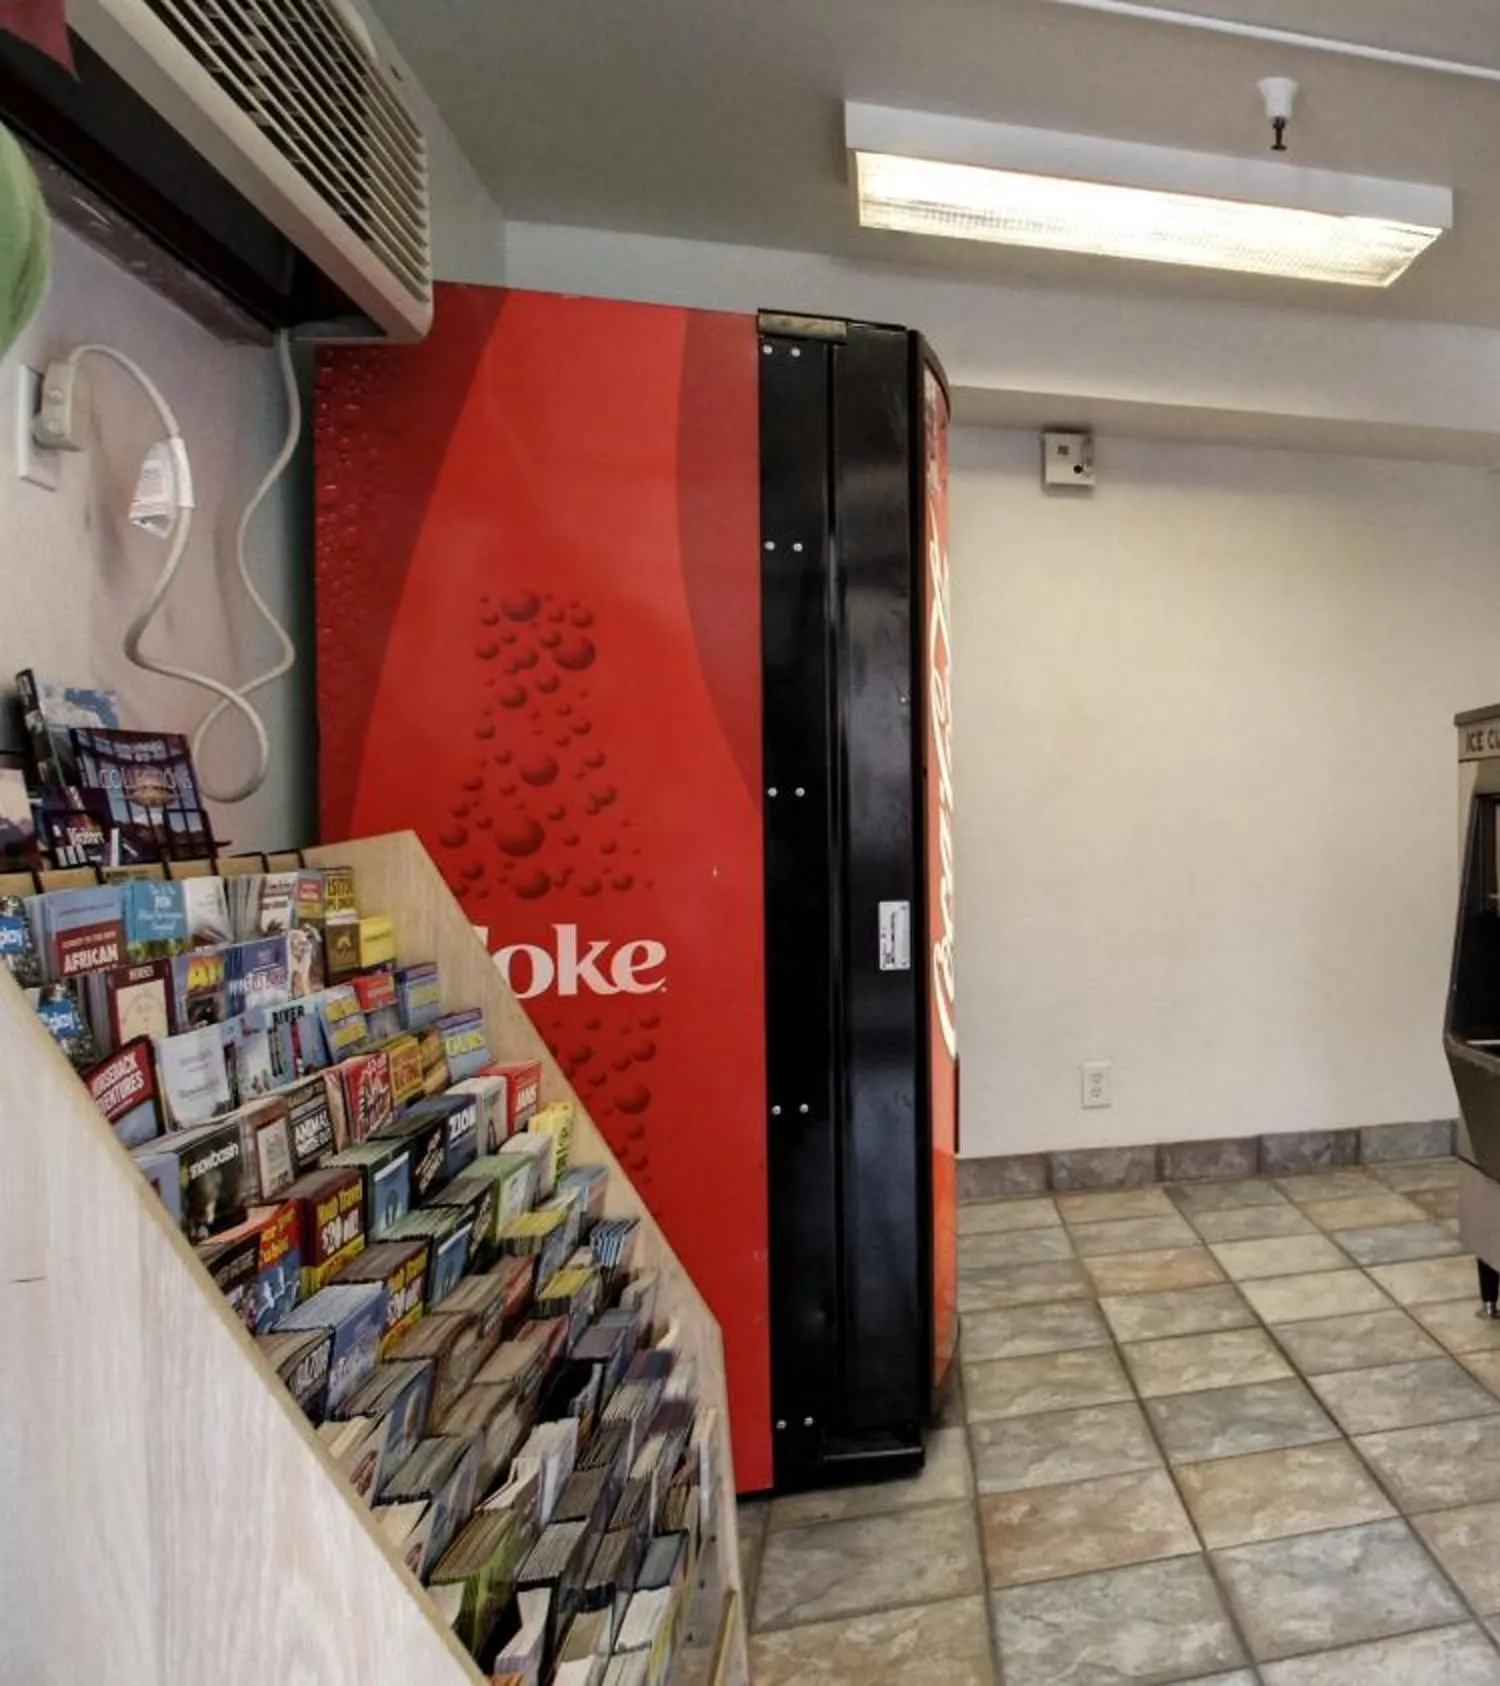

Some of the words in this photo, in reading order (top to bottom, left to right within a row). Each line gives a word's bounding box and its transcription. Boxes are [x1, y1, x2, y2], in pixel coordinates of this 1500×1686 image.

[1466, 730, 1484, 752] ICE
[63, 943, 119, 973] AFRICAN
[472, 923, 667, 999] oke
[272, 1005, 305, 1027] RIVER
[448, 1105, 477, 1140] ZION
